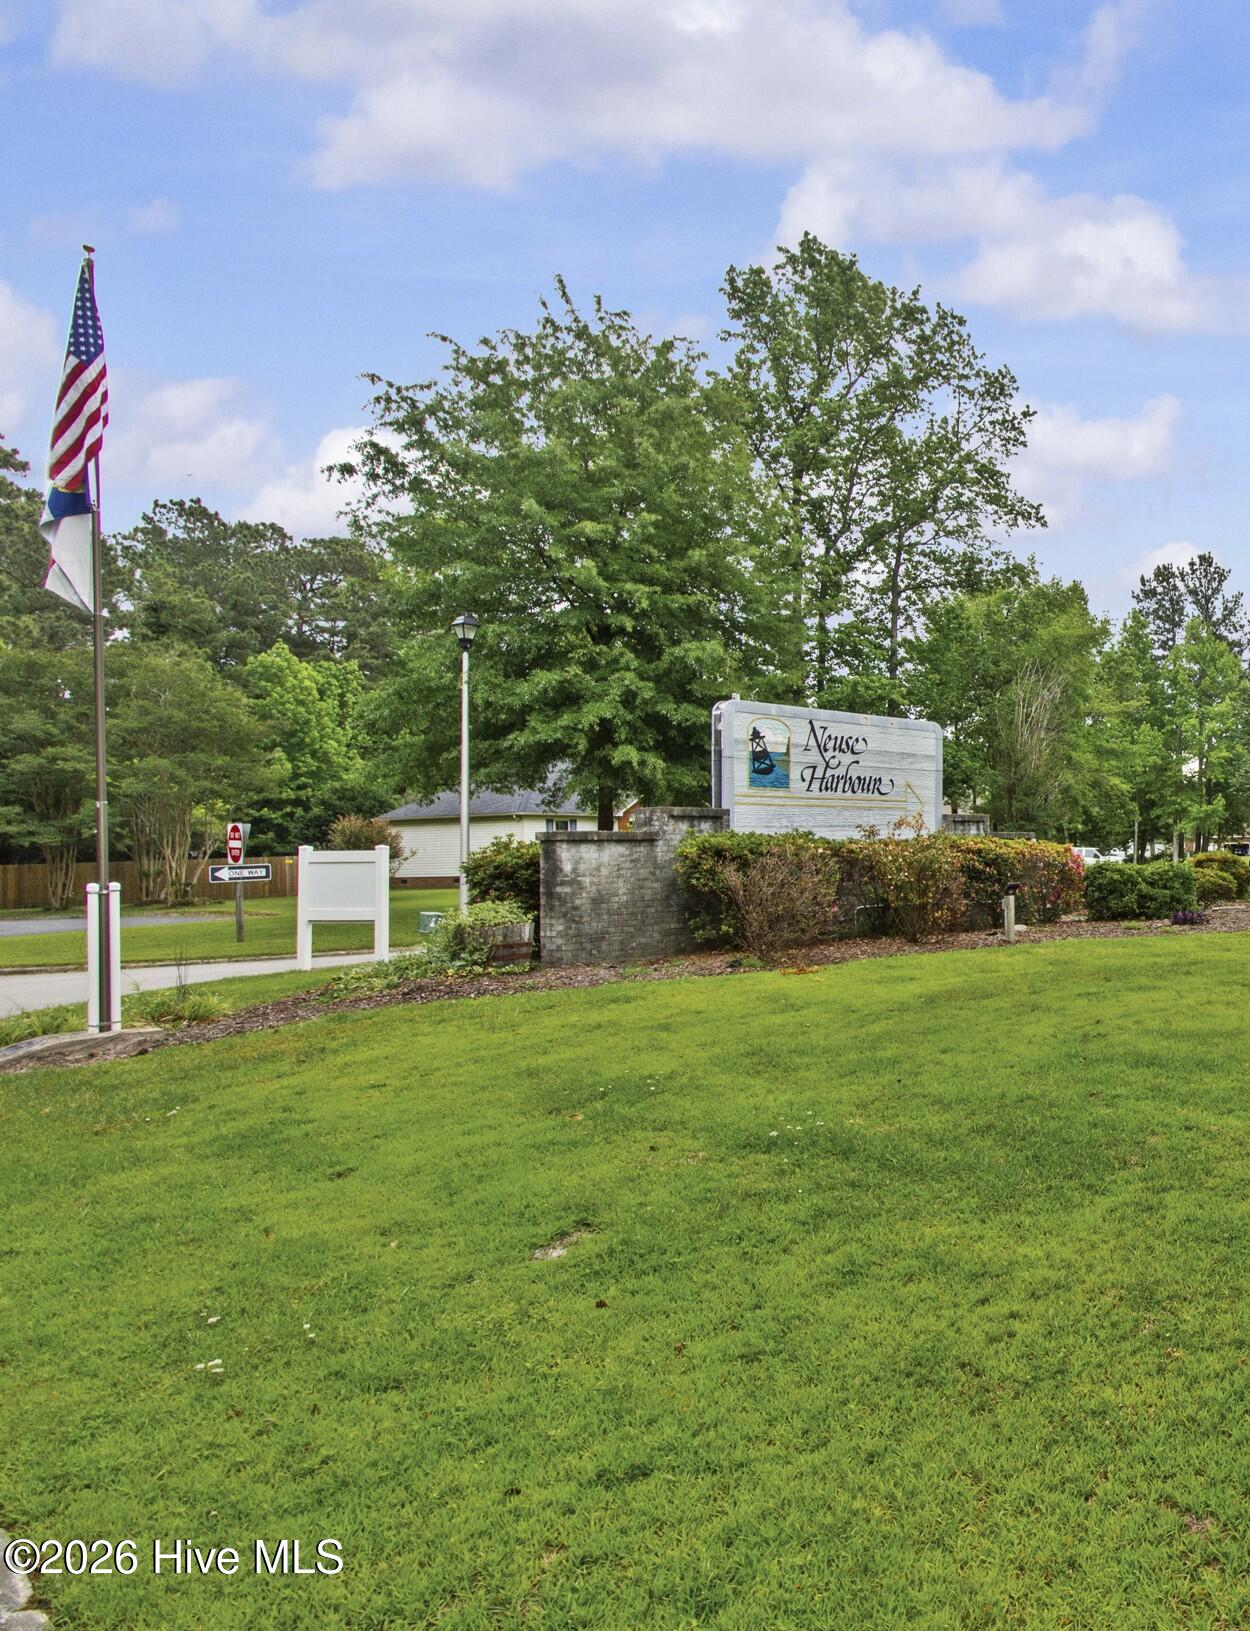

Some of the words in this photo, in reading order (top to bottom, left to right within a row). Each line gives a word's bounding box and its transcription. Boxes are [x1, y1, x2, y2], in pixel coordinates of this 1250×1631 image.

[803, 719, 868, 760] Neuse
[801, 756, 894, 796] Harbour
[247, 868, 264, 876] WAY
